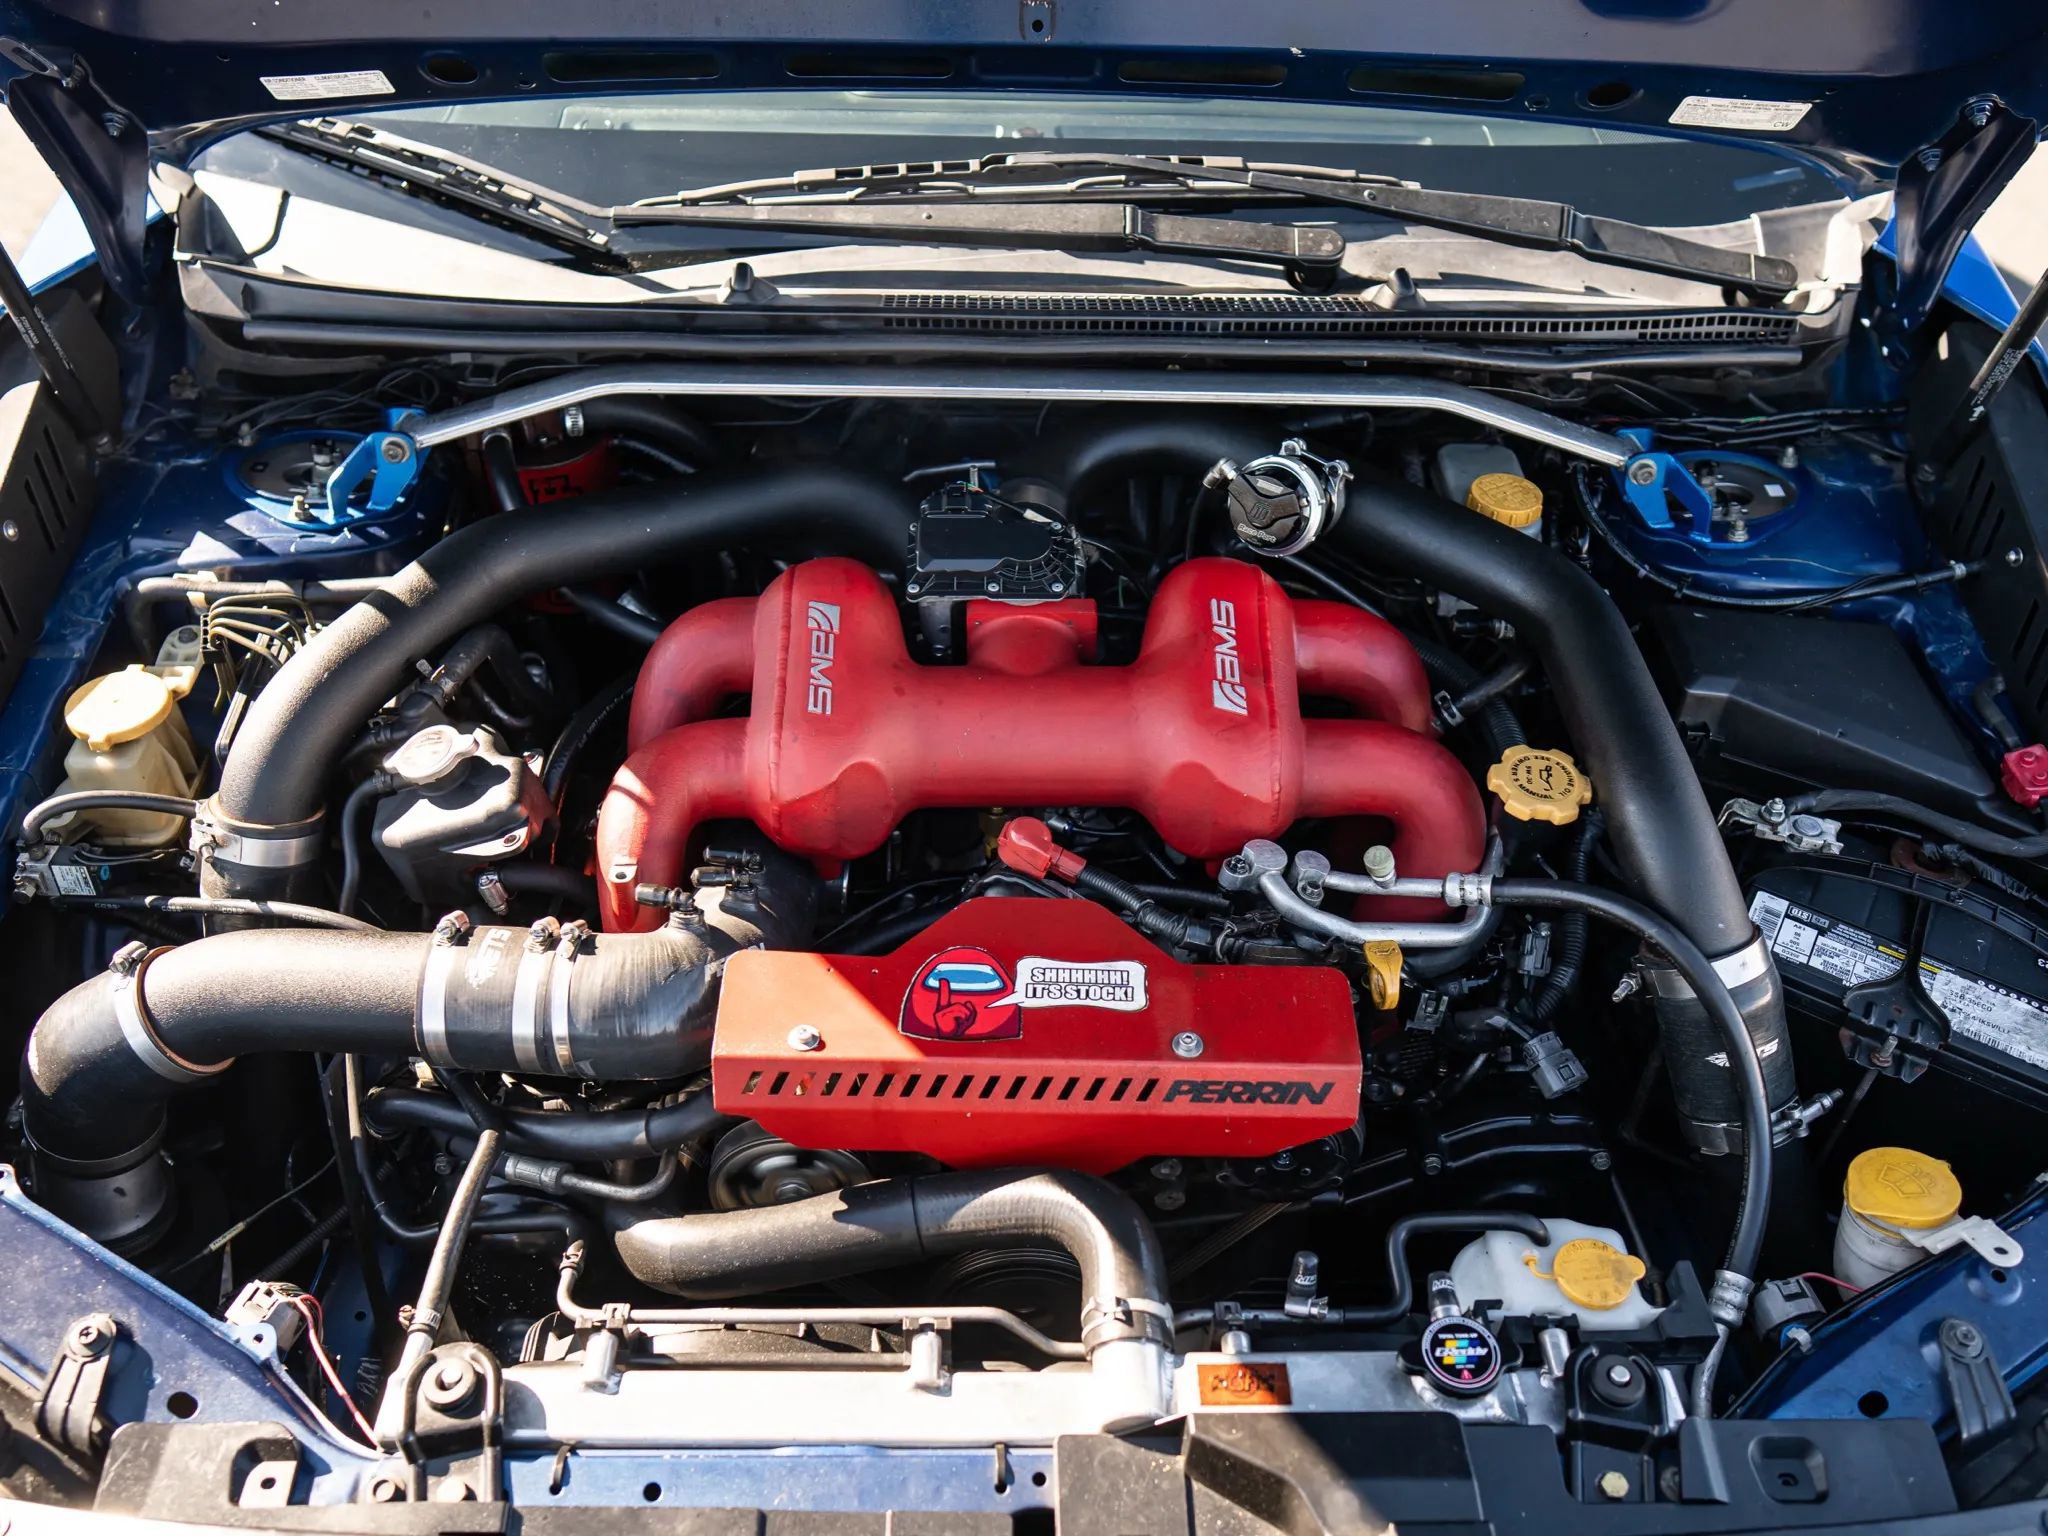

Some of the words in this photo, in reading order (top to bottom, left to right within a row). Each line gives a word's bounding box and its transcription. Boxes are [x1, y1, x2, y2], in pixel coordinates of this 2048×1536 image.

[1518, 783, 1555, 800] MANUAL
[1030, 967, 1130, 986] SHHHHHH!
[1025, 982, 1063, 1000] IT'S
[1063, 983, 1135, 1002] STOCK!
[1162, 1079, 1336, 1105] PERRIN
